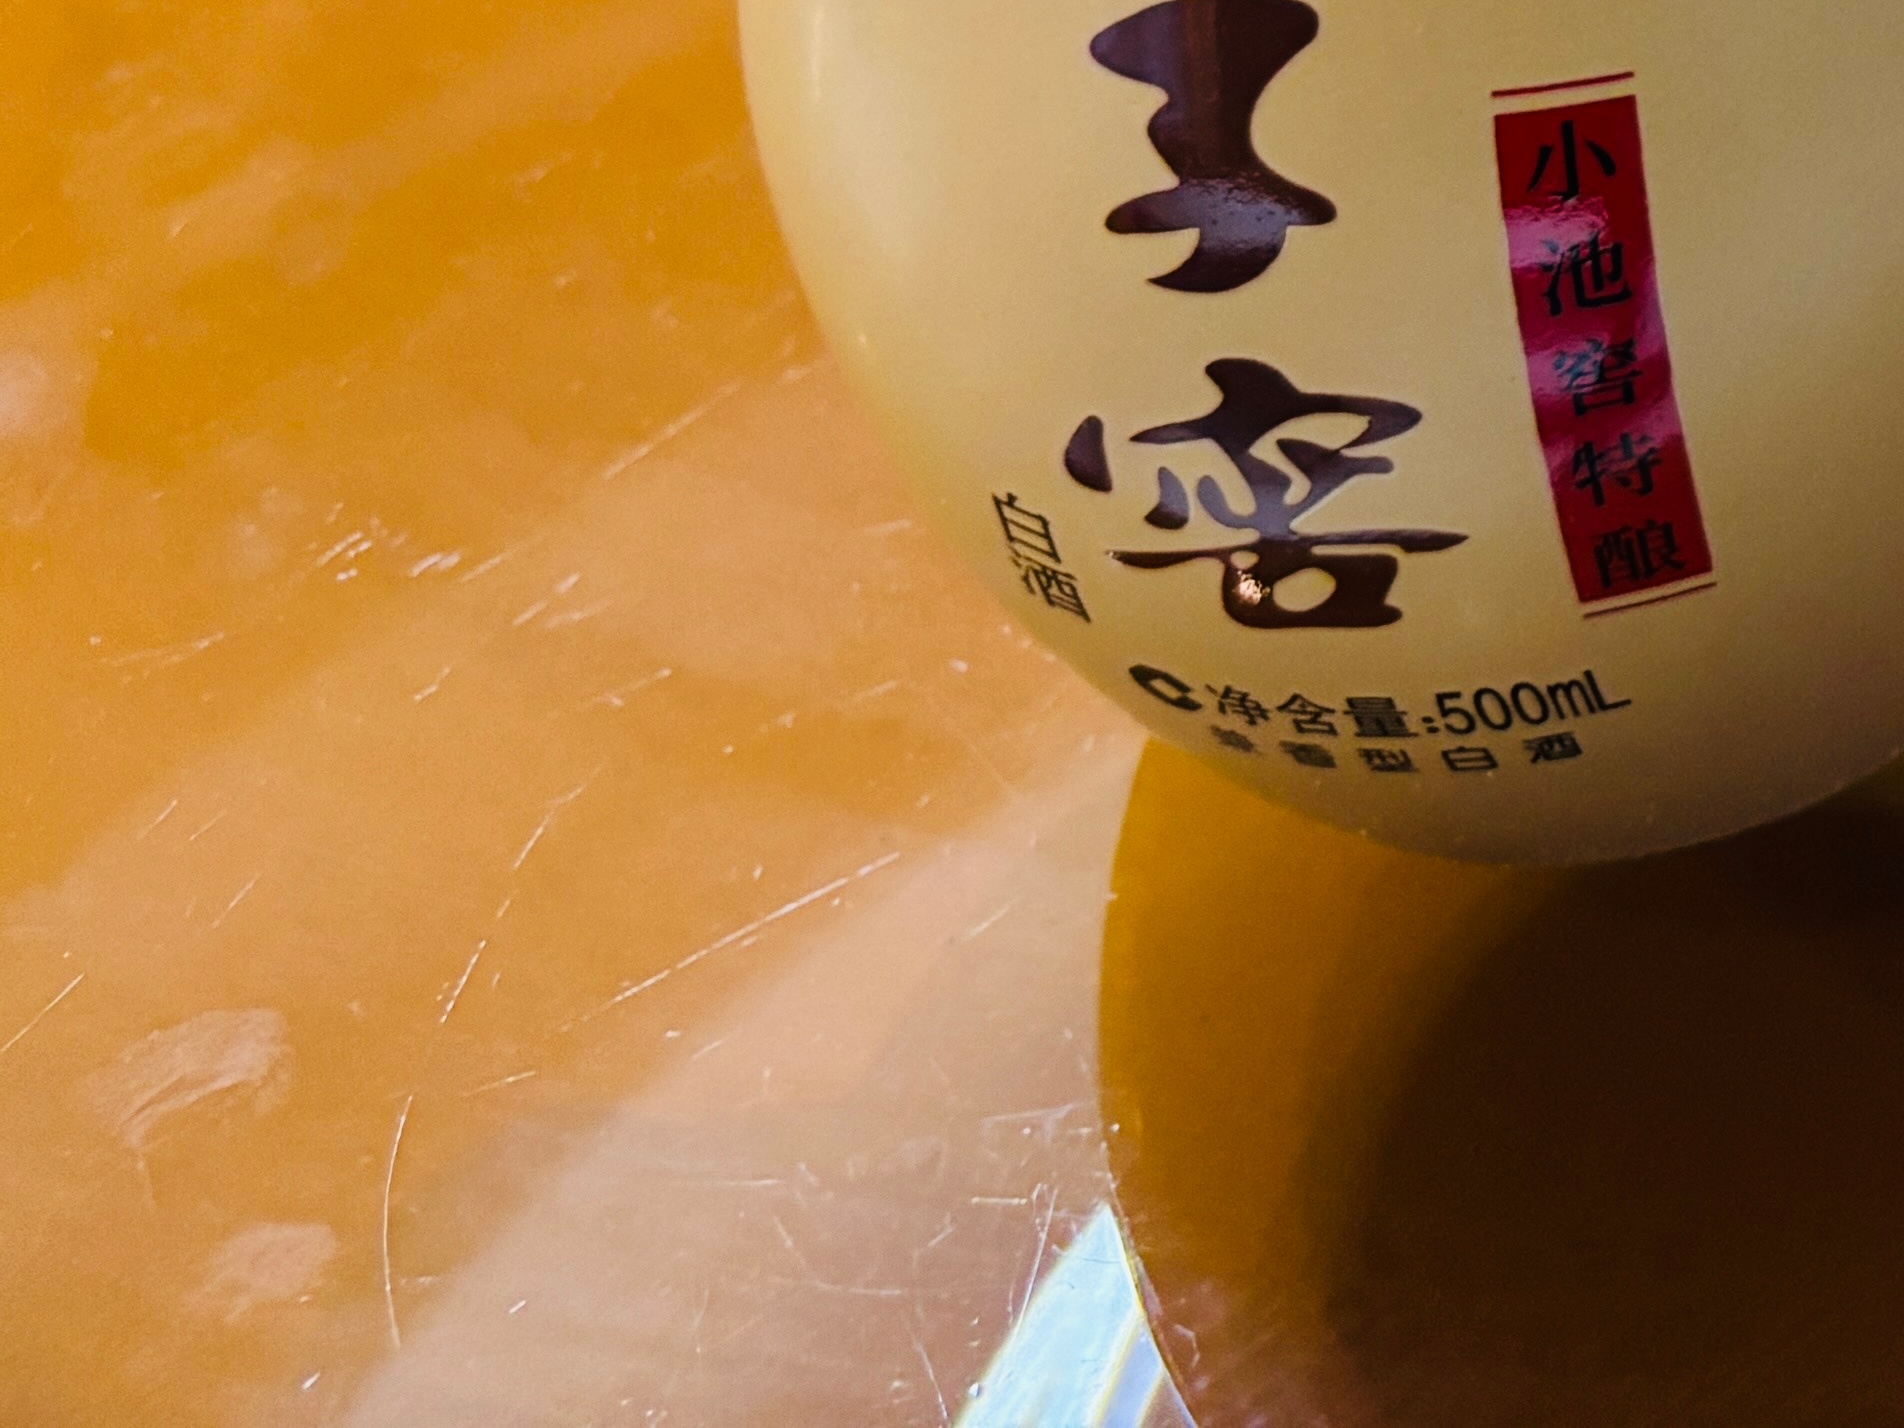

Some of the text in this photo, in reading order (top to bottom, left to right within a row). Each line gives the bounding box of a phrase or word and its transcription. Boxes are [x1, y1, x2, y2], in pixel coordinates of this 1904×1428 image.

[1525, 118, 1688, 590] 小池窖特酿
[991, 491, 1093, 623] 白酒
